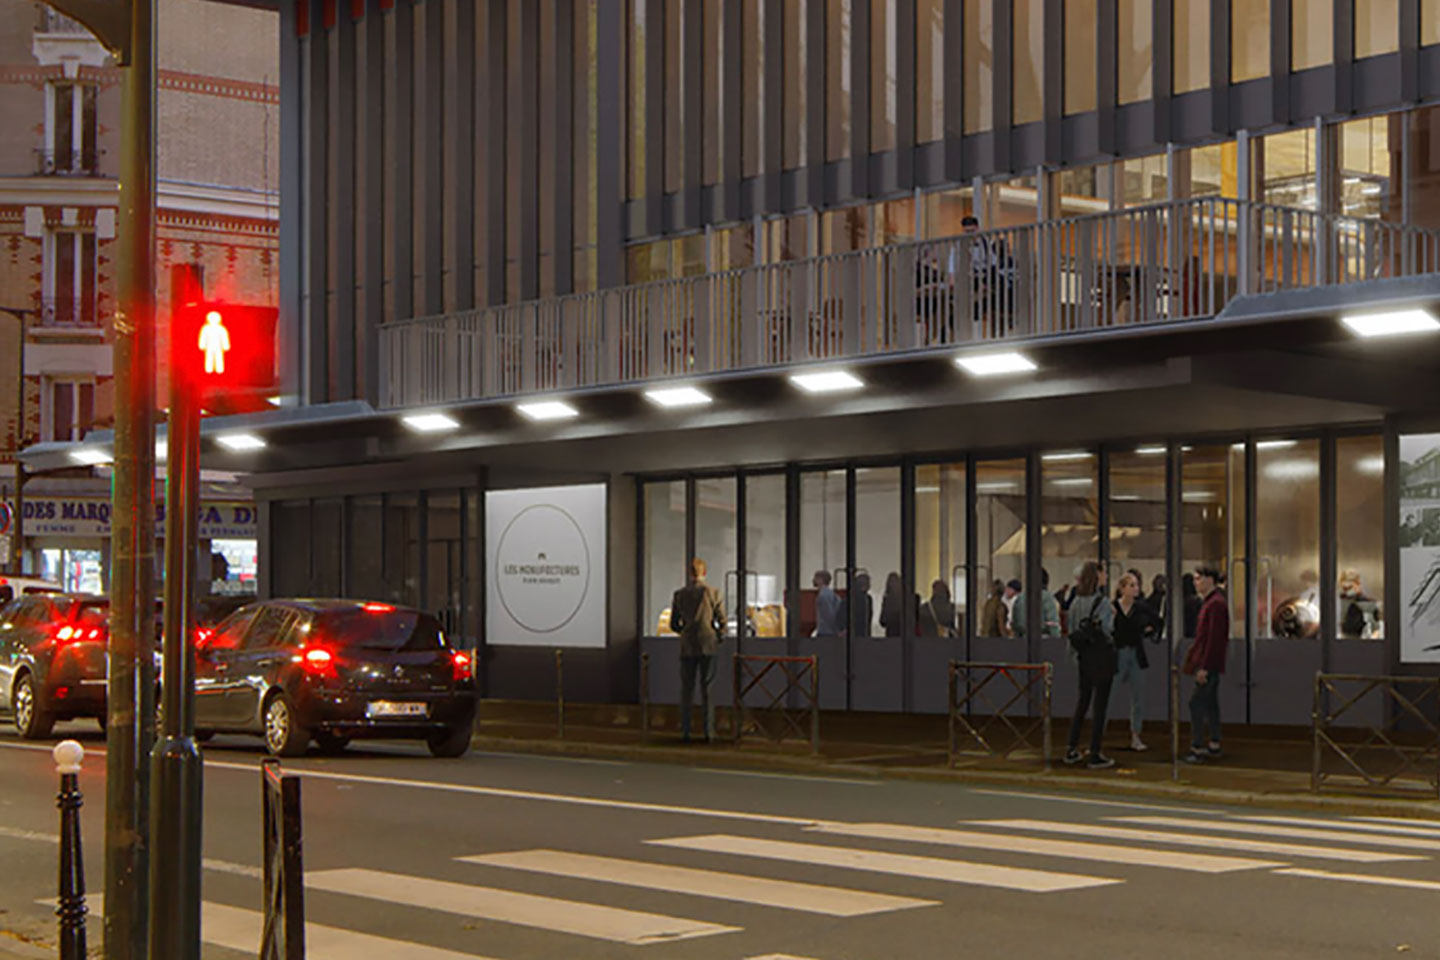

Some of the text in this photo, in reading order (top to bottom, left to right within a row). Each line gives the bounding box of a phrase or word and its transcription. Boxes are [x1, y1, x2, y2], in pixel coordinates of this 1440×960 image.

[24, 502, 56, 519] DES
[62, 502, 112, 523] MARQ
[504, 565, 518, 575] LES
